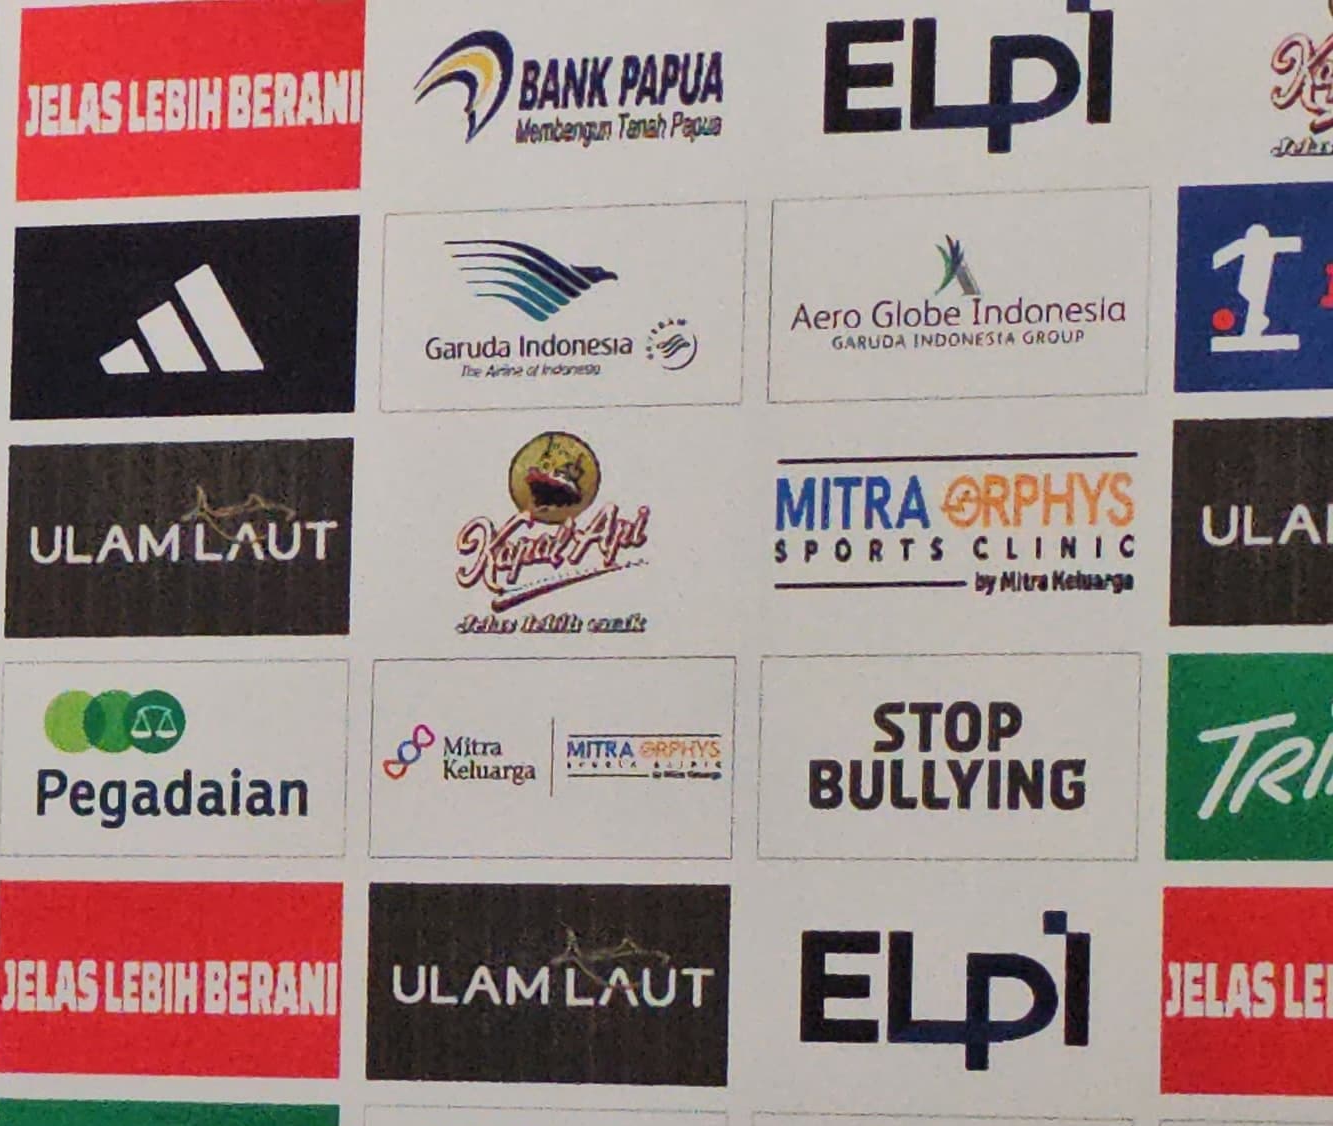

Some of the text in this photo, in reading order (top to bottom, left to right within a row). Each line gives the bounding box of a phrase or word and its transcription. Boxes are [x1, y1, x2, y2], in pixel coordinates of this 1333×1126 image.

[519, 52, 723, 111] BANK PAPUA
[26, 70, 362, 137] JELAS LEBIH BERANI
[618, 113, 665, 141] Tanah
[670, 113, 722, 144] Papua
[791, 297, 1126, 331] Aero Globe Indonesia
[426, 336, 511, 362] Garuda
[519, 334, 633, 359] Indonesia
[832, 330, 1084, 350] GARUDA INDONESIA GROUP
[774, 472, 1134, 532] MITRA ORPHYS
[30, 521, 337, 565] ULAM LAUT
[774, 535, 1135, 563] SPORTS CLINIC
[975, 572, 1134, 596] by Mitra Keluarga
[443, 735, 503, 757] Mitra
[874, 702, 1022, 752] STOP
[443, 759, 536, 784] Keluarga
[566, 741, 632, 760] MITRA
[37, 768, 308, 829] Pegadaian
[809, 759, 1086, 811] BULLYING
[1, 961, 338, 1016] JELAS LEBIH BERANI
[393, 966, 714, 1008] ULAM LAUT
[1166, 961, 1275, 1019] JELAS
